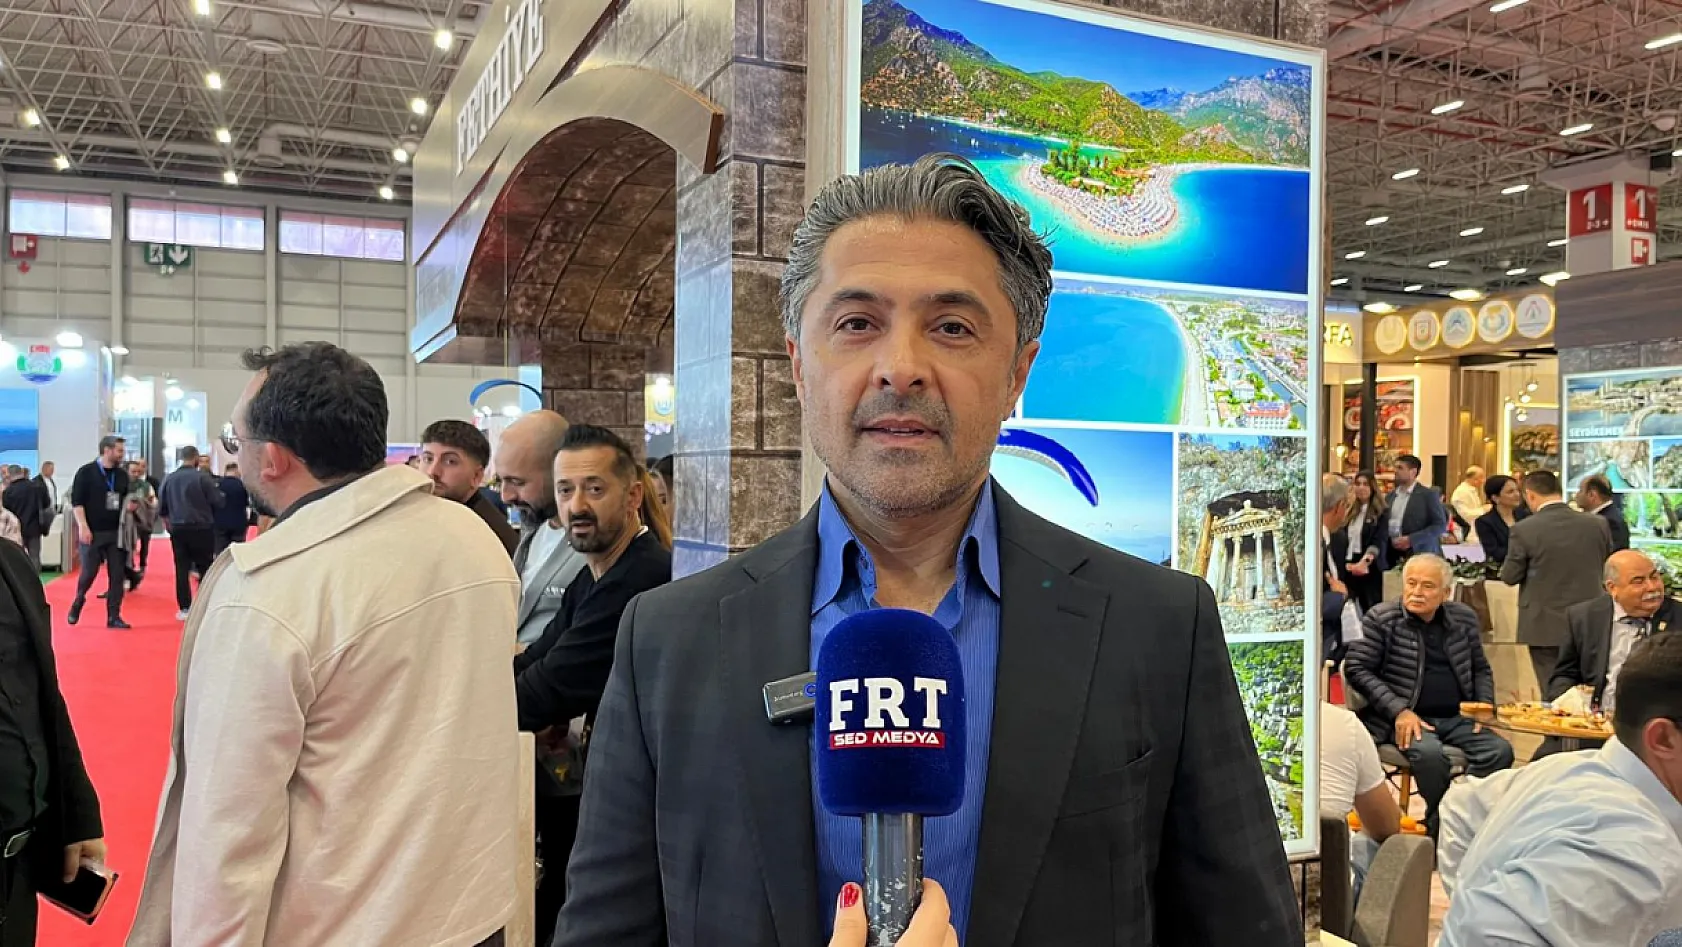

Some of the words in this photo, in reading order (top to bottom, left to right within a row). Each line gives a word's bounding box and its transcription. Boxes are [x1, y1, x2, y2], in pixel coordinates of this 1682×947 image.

[456, 0, 544, 177] FETHİYE
[1583, 190, 1596, 220] 1
[1635, 188, 1646, 219] 1
[829, 676, 947, 731] FRT
[834, 732, 867, 746] SED
[872, 731, 939, 744] MEDYA
